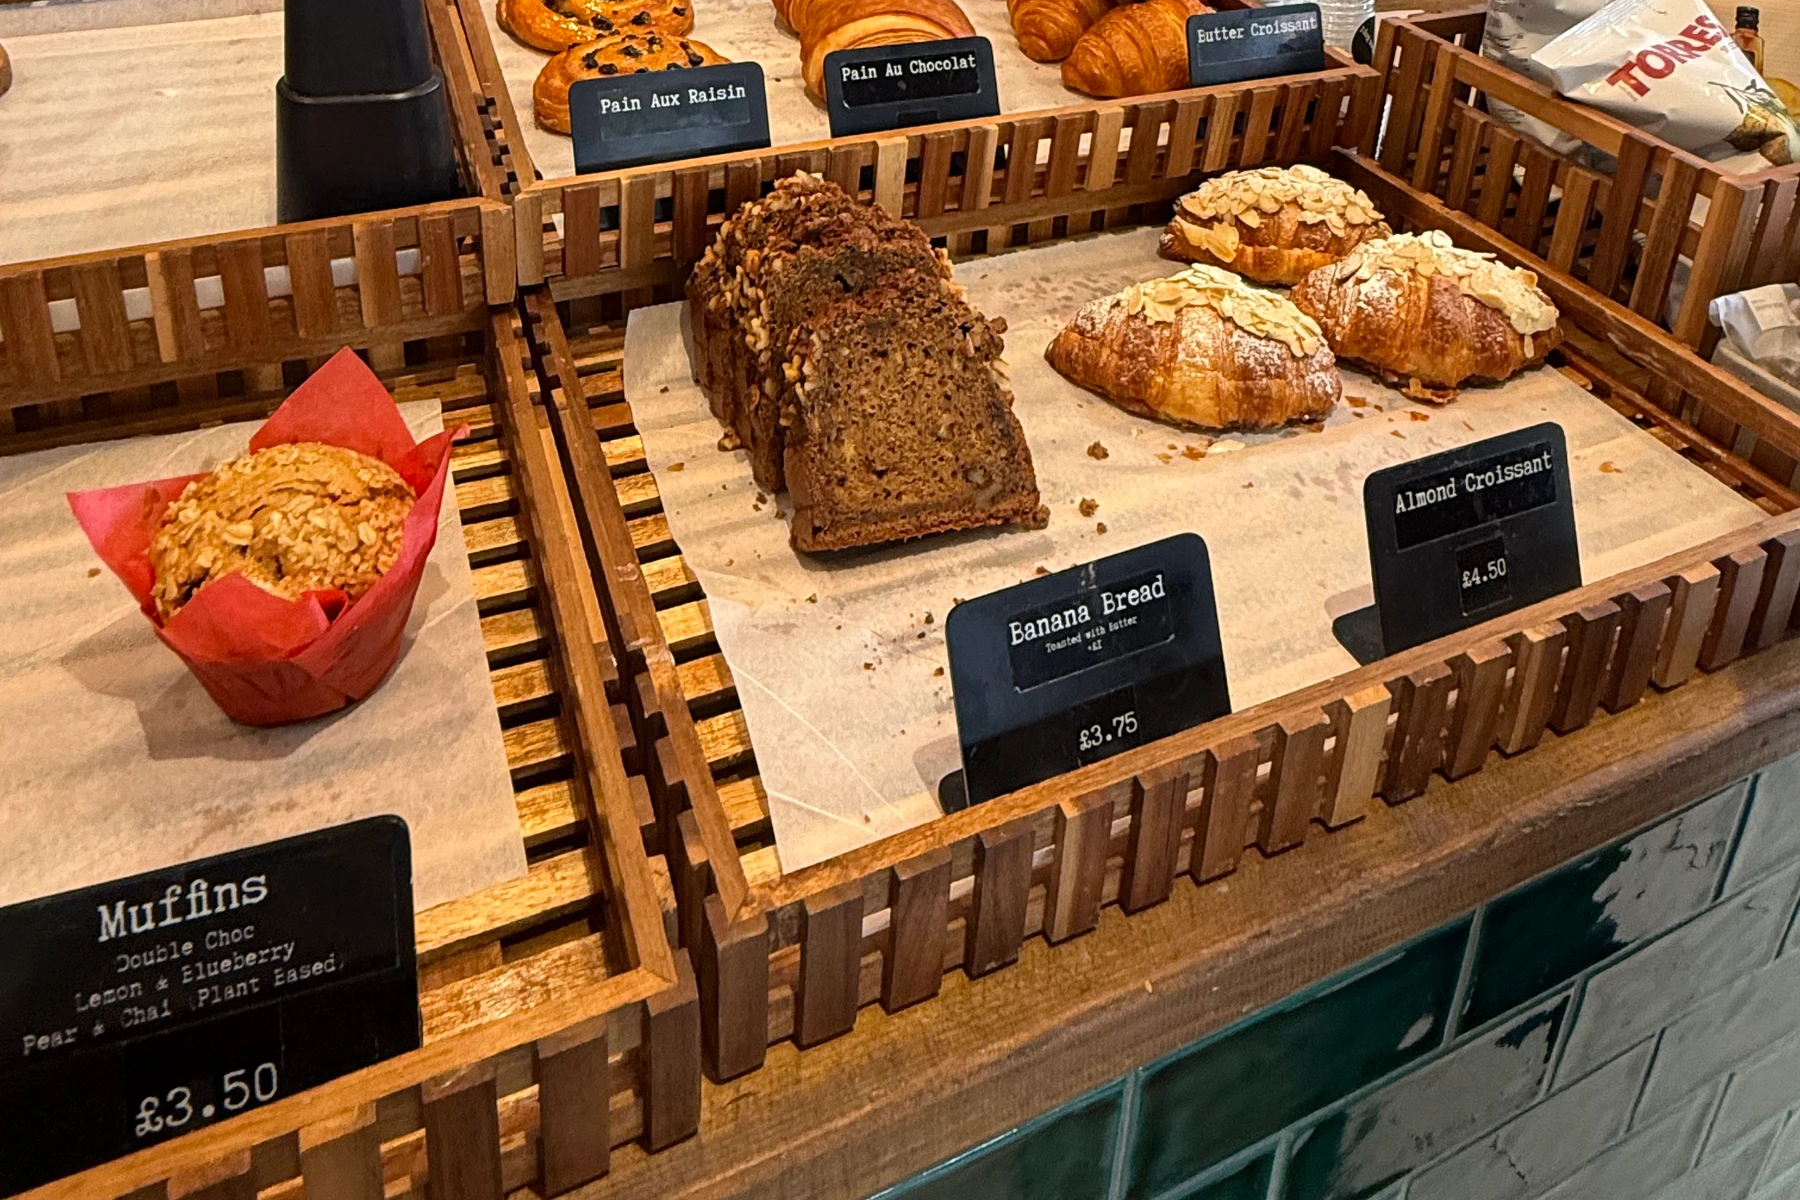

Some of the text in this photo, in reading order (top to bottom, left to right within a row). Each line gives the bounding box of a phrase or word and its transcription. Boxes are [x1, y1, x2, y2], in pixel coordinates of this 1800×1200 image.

[1197, 16, 1318, 44] Butter Croissant
[841, 53, 977, 82] Pain Au Chocolat
[1605, 14, 1729, 98] TORRES
[600, 84, 747, 115] Pain Aux Raisin
[1395, 450, 1553, 515] Almond Croissant
[1461, 557, 1508, 589] £4.50
[1008, 573, 1167, 647] Banana Bread
[1045, 632, 1083, 653] Toasted
[1085, 625, 1106, 640] with
[1078, 710, 1140, 751] £3.75
[97, 873, 269, 943] Muffins
[116, 924, 255, 974] Double Choc
[75, 981, 144, 1013] Lemon
[154, 975, 169, 992] &
[21, 1027, 79, 1057] Pear
[91, 1023, 107, 1037] &
[120, 999, 173, 1029] Chai
[134, 1061, 279, 1139] £3.50
